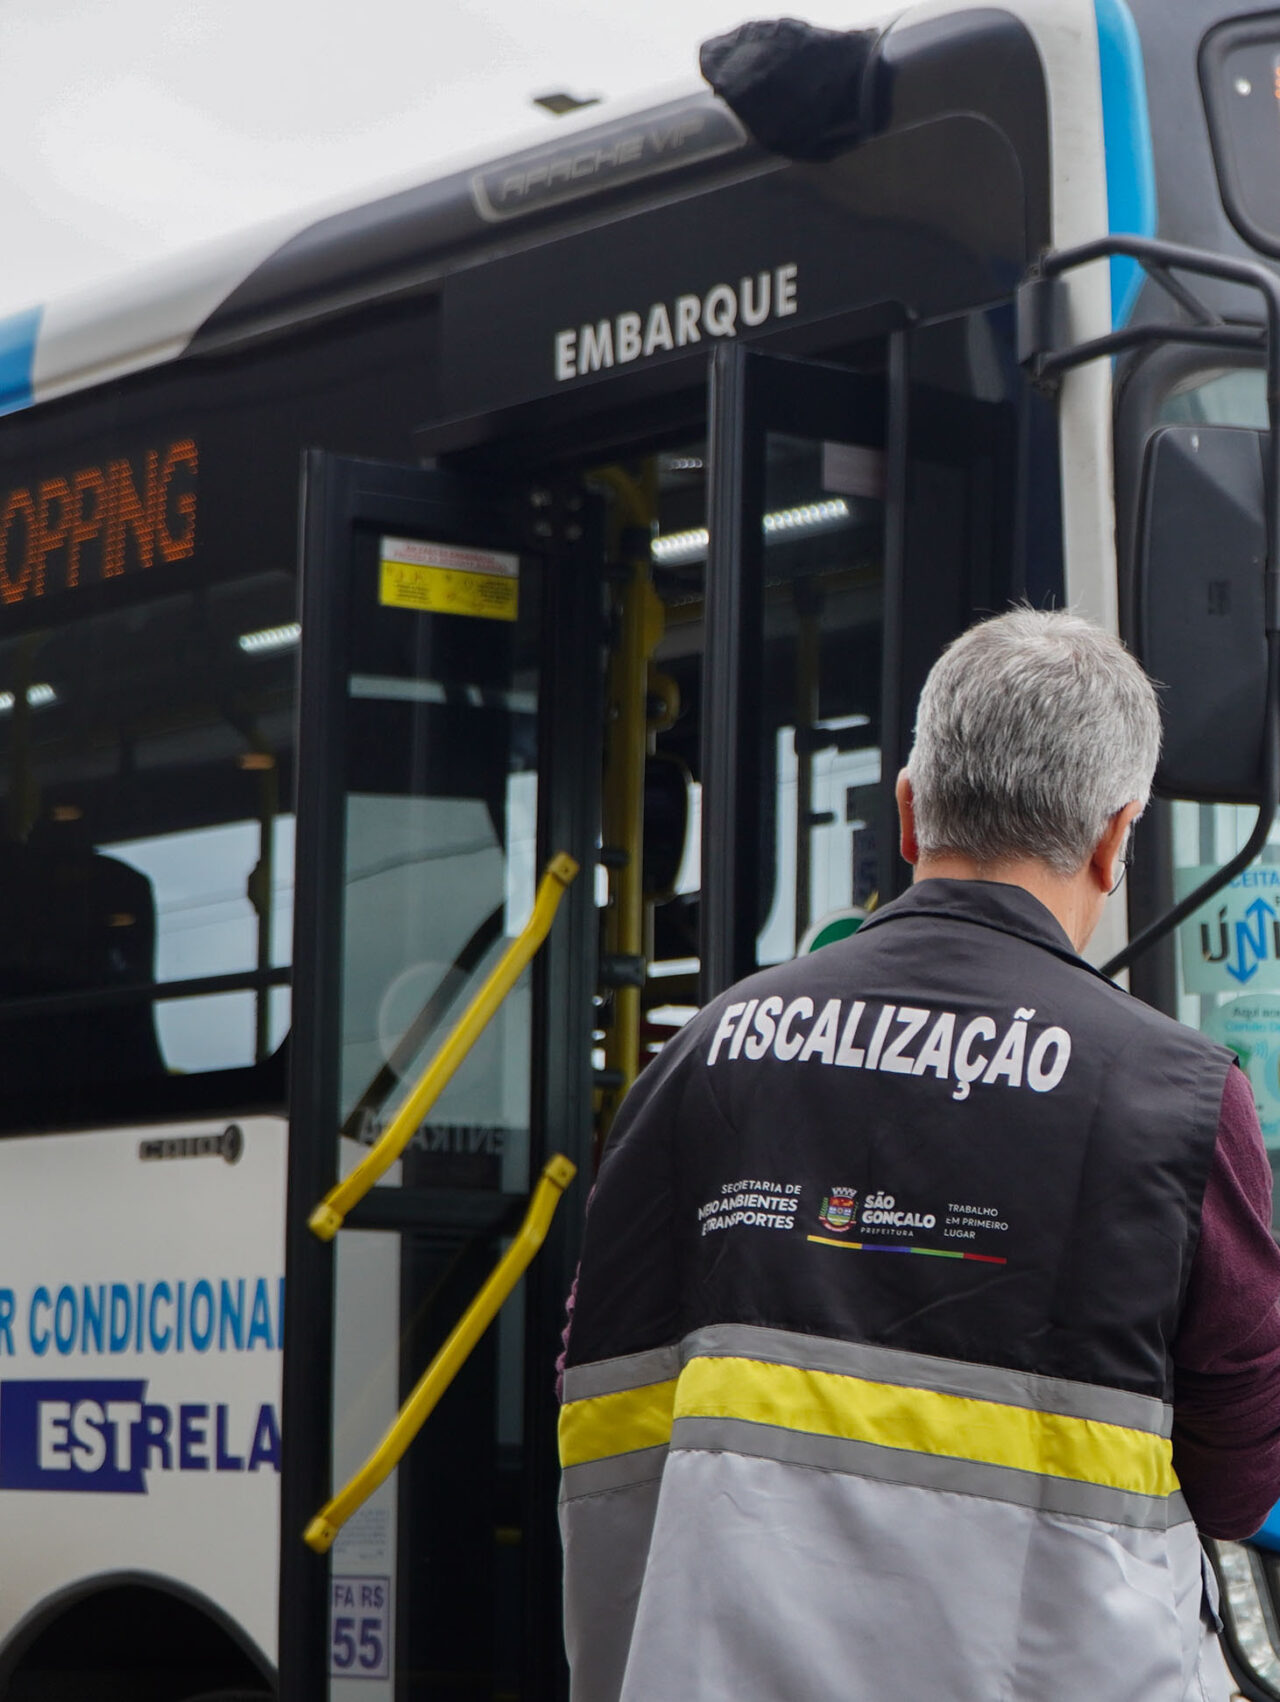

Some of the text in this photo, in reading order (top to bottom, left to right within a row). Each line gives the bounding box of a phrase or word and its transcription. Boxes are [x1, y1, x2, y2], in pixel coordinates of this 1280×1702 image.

[554, 262, 798, 382] EMBARQUE
[706, 995, 1072, 1101] FISCALIZAÇÃO
[721, 1179, 803, 1195] SECETARIA DE
[864, 1190, 896, 1209] SÃO
[861, 1210, 936, 1229] GONÇALO
[947, 1203, 999, 1217] TRABALHO
[860, 1226, 914, 1237] PREFEITURA
[945, 1216, 1009, 1231] EM PRIMEIRO
[943, 1228, 977, 1239] LUGAR
[29, 1277, 286, 1357] CONDICIONA
[37, 1399, 282, 1473] ESTRELA
[361, 1585, 385, 1610] R$
[332, 1616, 384, 1670] 55
